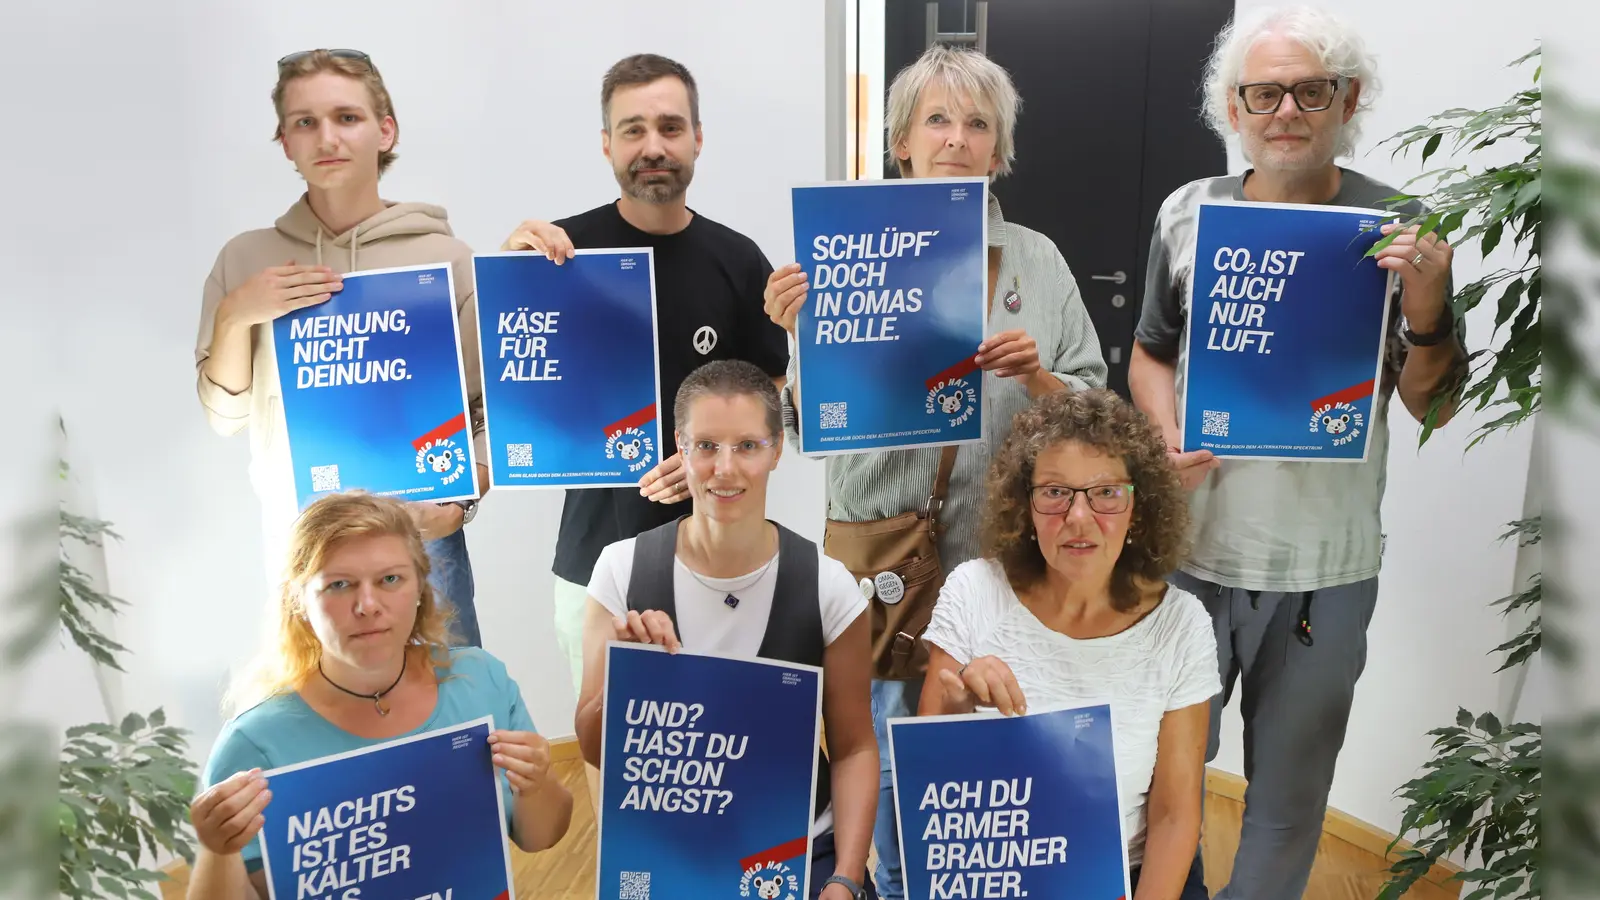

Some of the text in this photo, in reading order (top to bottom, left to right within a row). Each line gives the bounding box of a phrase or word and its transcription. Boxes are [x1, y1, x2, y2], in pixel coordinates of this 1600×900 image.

[814, 262, 887, 289] DOCH
[1259, 250, 1305, 275] IST
[815, 287, 923, 317] IN OMAS
[1209, 275, 1285, 301] AUCH
[290, 309, 411, 339] MEINUNG,
[498, 307, 560, 334] KÄSE
[1209, 302, 1265, 327] NUR
[816, 317, 900, 344] ROLLE.
[1207, 328, 1274, 354] LUFT.
[294, 336, 369, 364] NICHT
[500, 334, 547, 358] FÜR
[297, 359, 412, 389] DEINUNG.
[500, 360, 562, 381] ALLE.
[925, 381, 944, 414] SCHULD
[948, 378, 968, 388] HAT
[965, 388, 977, 403] DIE
[1309, 404, 1331, 432] SCHULD
[1335, 402, 1357, 412] HAT
[1353, 413, 1364, 427] DIE
[416, 441, 432, 473] SCHULD
[435, 438, 456, 448] HAT
[454, 448, 466, 462] DIE
[604, 429, 622, 459] SCHULD
[625, 427, 645, 437] HAT
[643, 437, 653, 451] DIE
[878, 574, 894, 583] OMAS
[879, 580, 897, 590] GEGEN
[625, 699, 704, 728] UND?
[623, 728, 749, 760] HAST DU
[623, 757, 724, 786] SCHON
[620, 785, 733, 814] ANGST?
[919, 777, 1032, 810] ACH DU
[288, 785, 416, 843] NACHTS
[922, 809, 1029, 840] ARMER
[293, 822, 387, 872] IST ES
[927, 836, 1067, 870] BRAUNER
[297, 845, 411, 900] KÄLTER
[739, 861, 798, 897] SCHULD HAT DIE
[929, 871, 1028, 900] KATER.
